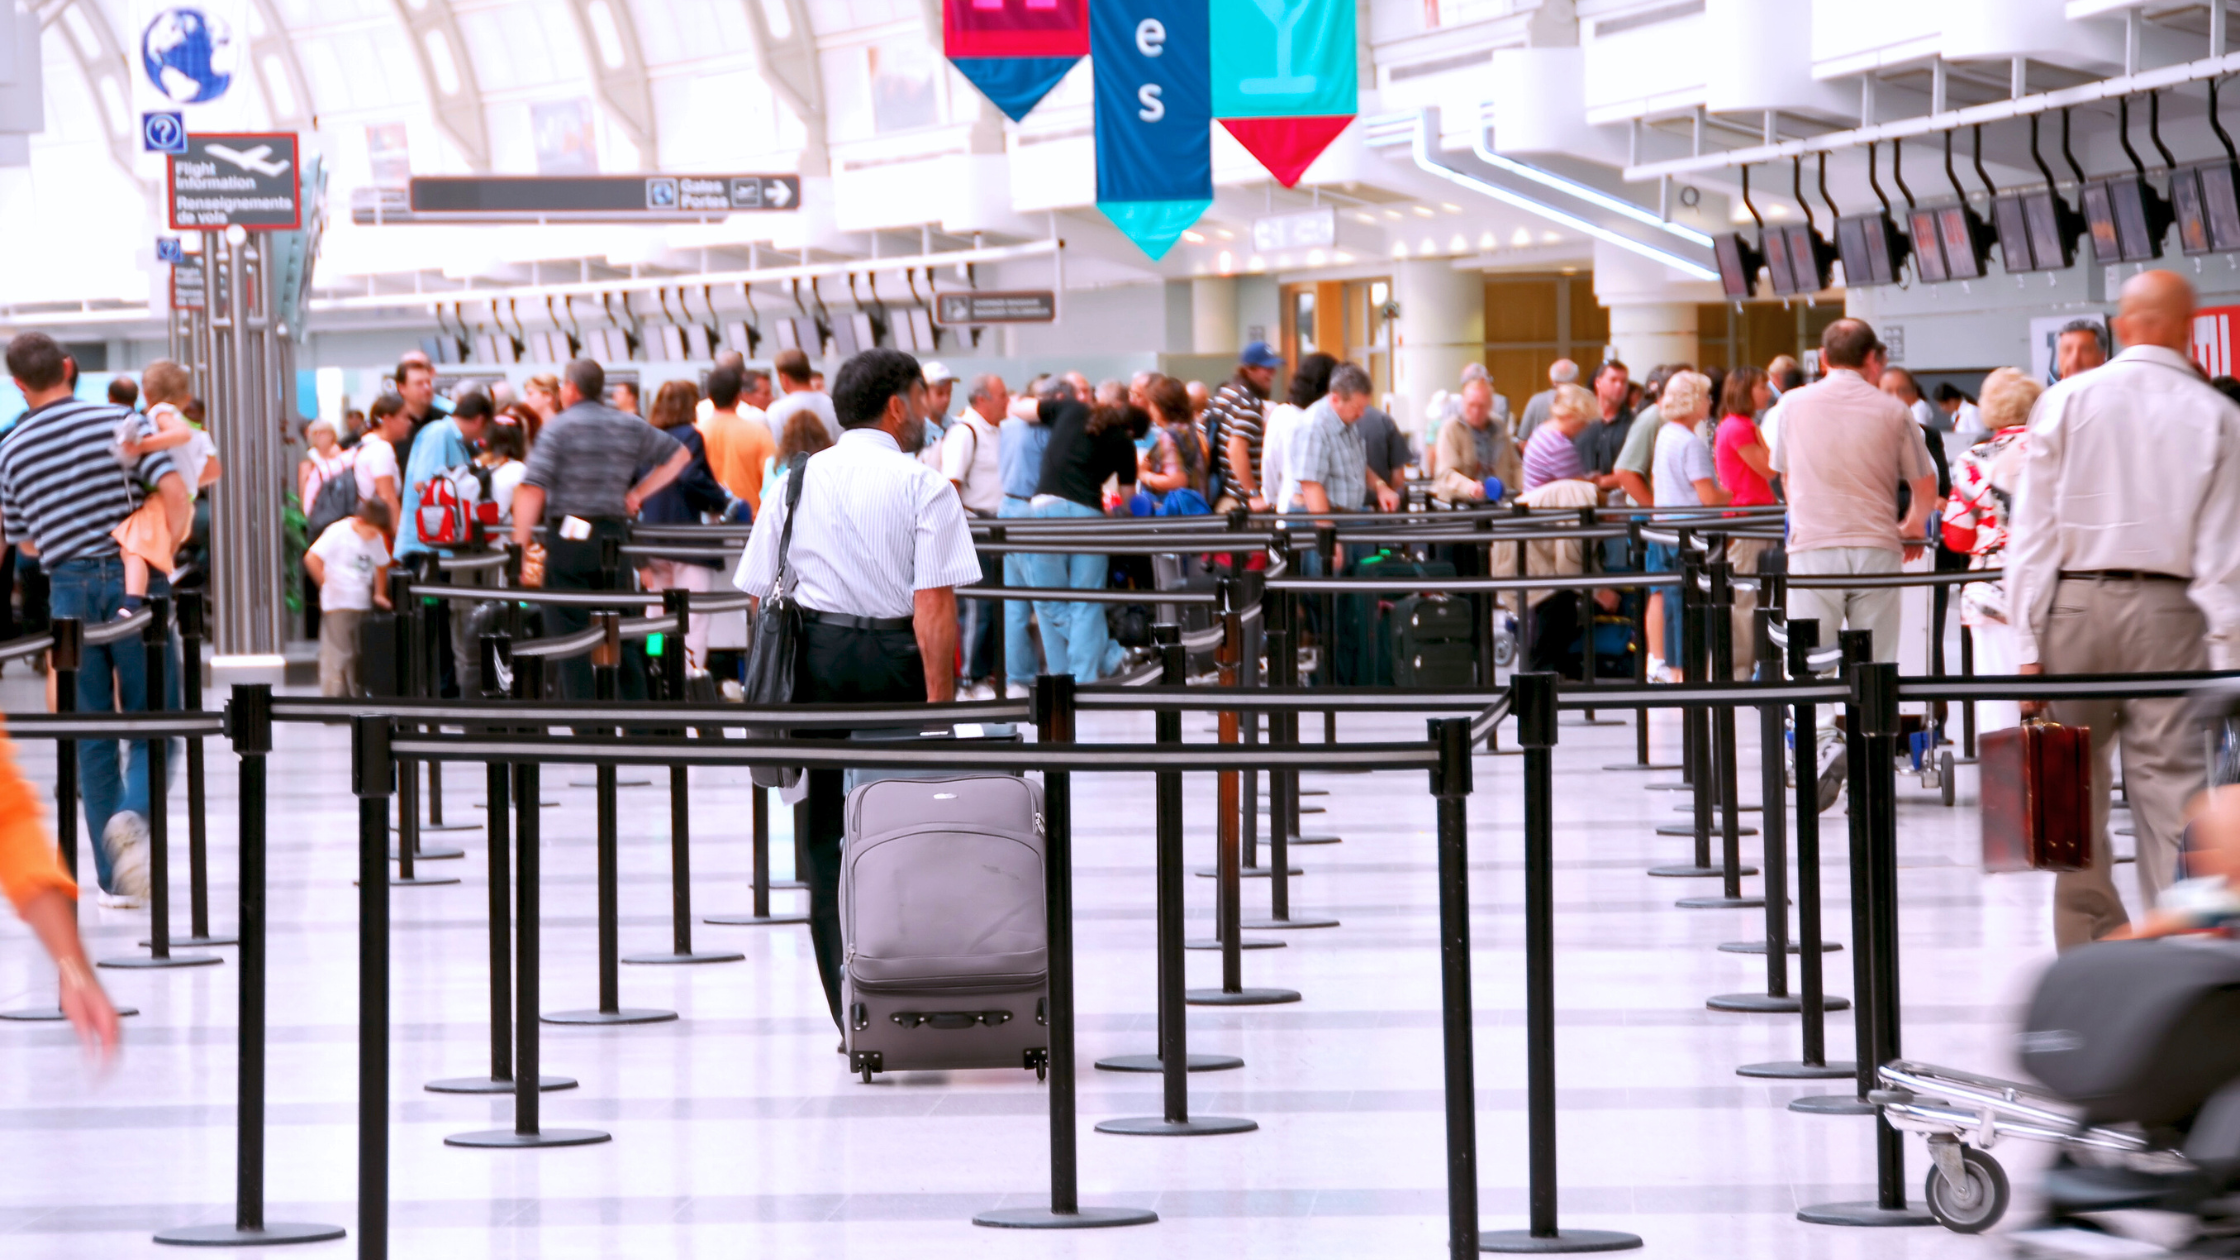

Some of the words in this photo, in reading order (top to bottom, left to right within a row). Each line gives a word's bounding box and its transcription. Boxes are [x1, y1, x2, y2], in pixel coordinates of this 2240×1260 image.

[175, 161, 216, 178] Flight
[175, 175, 257, 190] Information
[680, 178, 724, 194] Gates
[176, 196, 293, 214] Renseignements
[681, 193, 729, 209] Portes
[176, 211, 196, 225] de
[197, 211, 228, 225] vols
